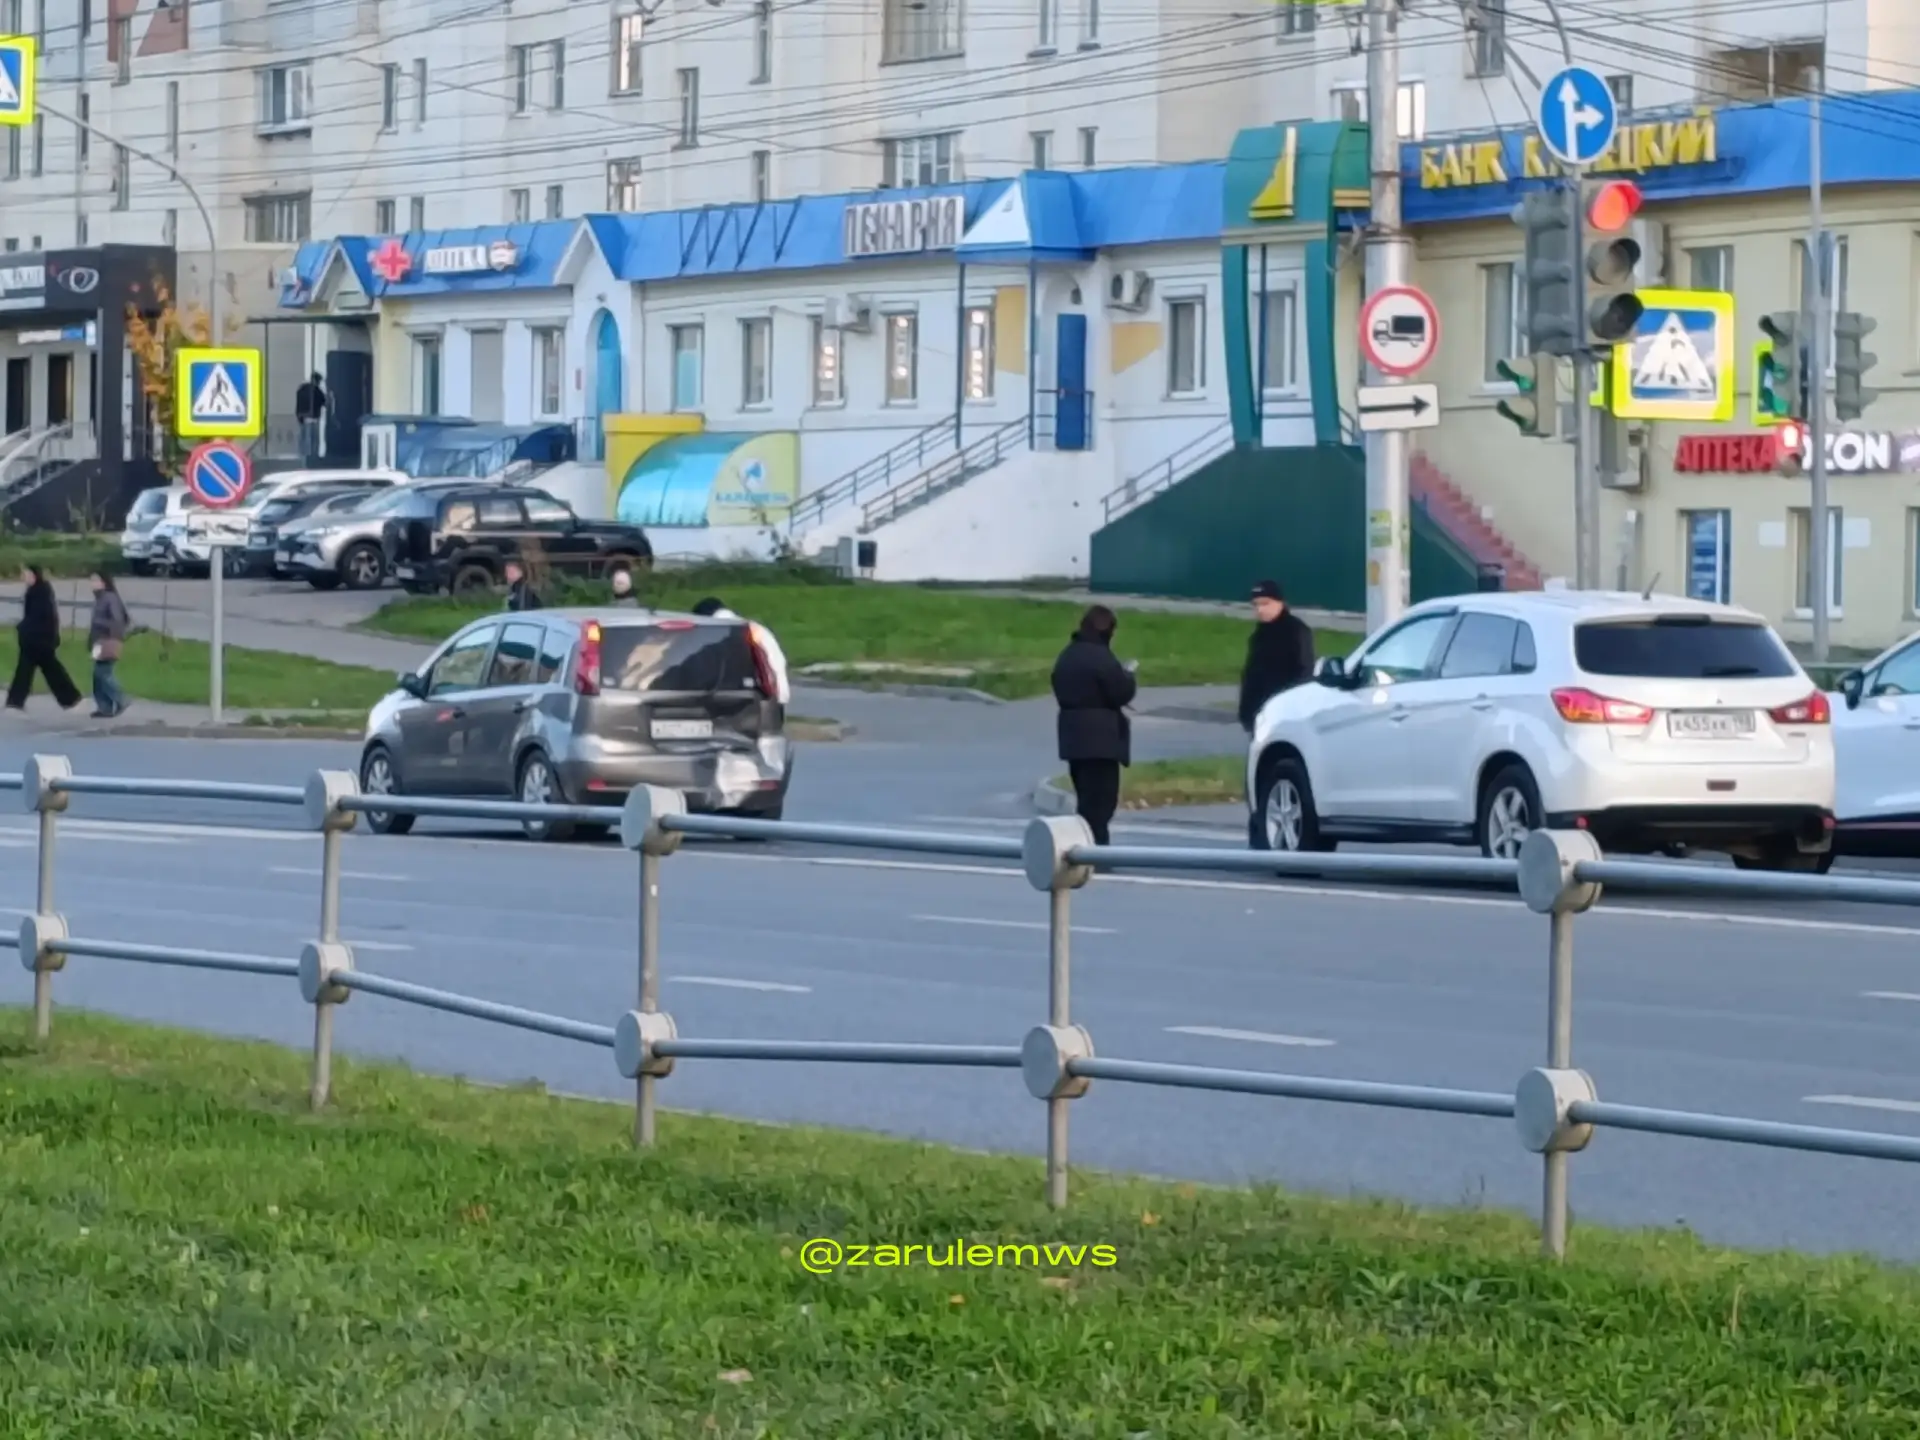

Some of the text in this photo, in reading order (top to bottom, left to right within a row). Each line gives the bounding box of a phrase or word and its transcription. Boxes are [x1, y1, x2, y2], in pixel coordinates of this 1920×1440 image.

[1421, 105, 1717, 188] БАНК КЦКИЙ
[1673, 434, 1778, 472] АПТЕКА
